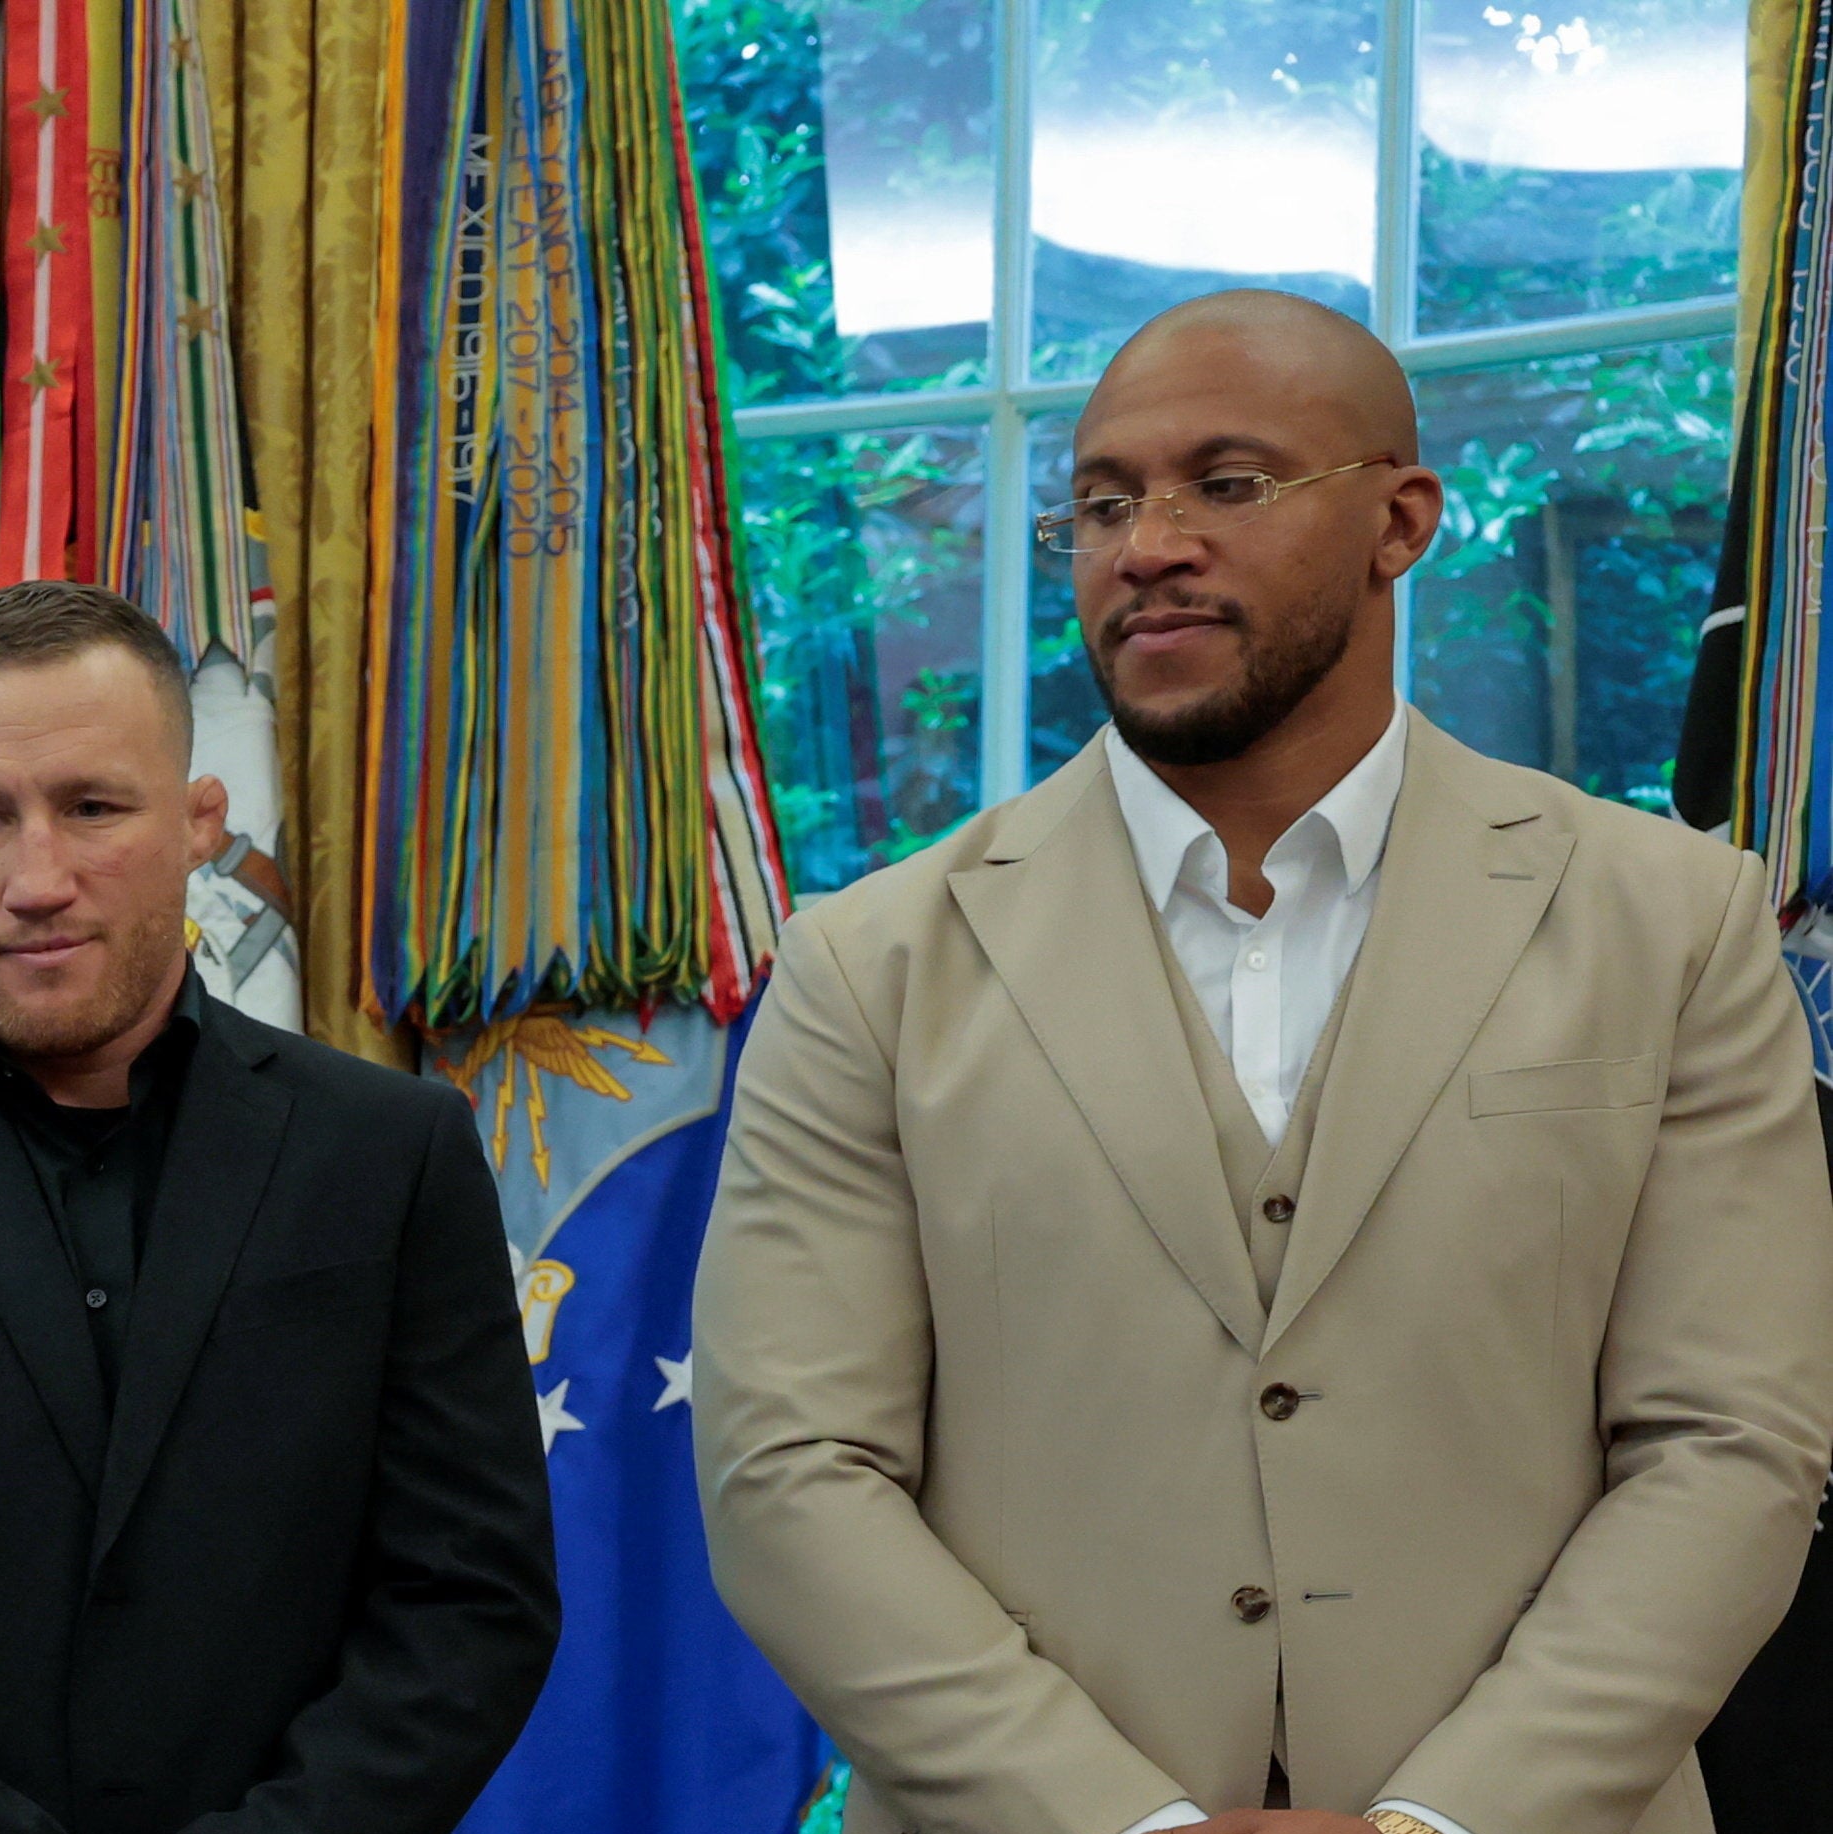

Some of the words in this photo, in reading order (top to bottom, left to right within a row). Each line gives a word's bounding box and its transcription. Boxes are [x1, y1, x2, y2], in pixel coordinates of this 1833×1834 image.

[451, 133, 494, 300] MEXICO
[504, 301, 542, 394] 2017
[546, 319, 580, 413] 2014
[505, 433, 543, 559] 2020
